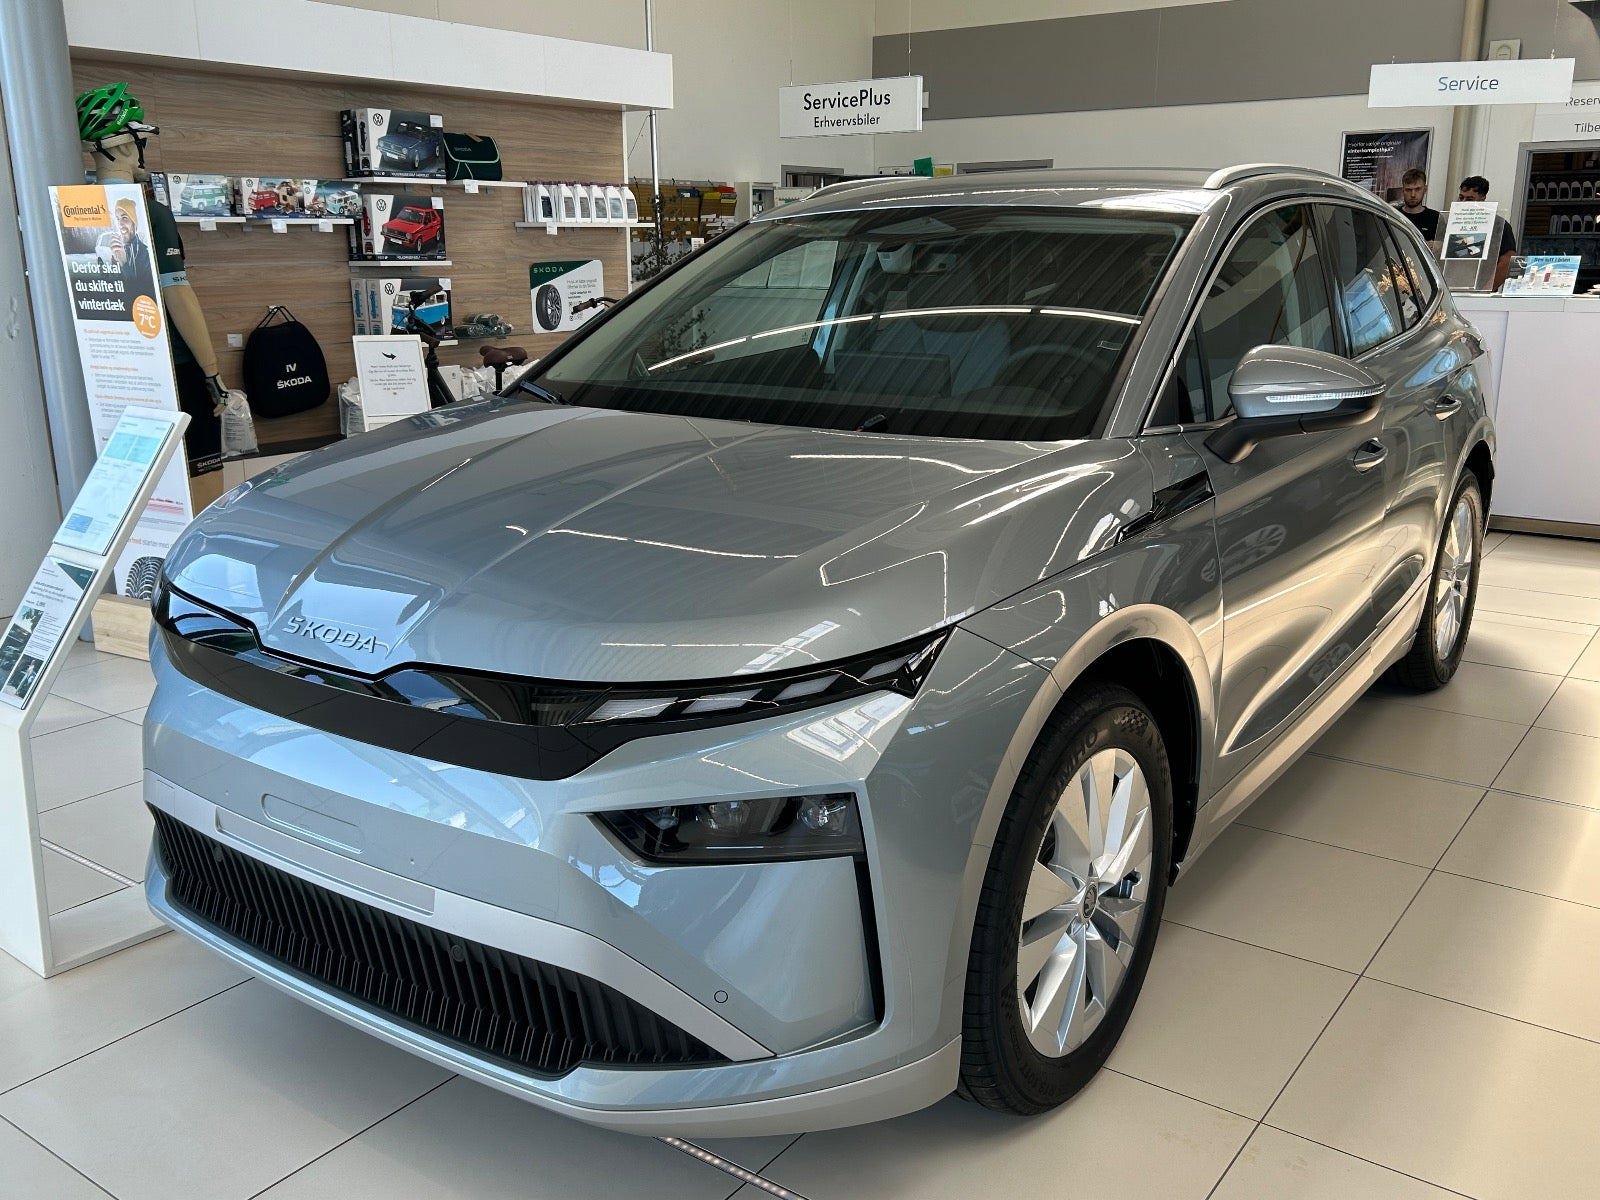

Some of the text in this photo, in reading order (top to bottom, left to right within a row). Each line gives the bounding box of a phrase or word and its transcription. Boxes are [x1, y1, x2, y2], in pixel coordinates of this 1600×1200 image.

[1438, 75, 1499, 91] Service
[803, 88, 891, 111] ServicePlus
[1565, 97, 1600, 106] Reser
[814, 113, 881, 128] Erhvervsbiler
[63, 204, 100, 218] Continental
[71, 261, 122, 274] Derfor skal
[75, 279, 125, 293] du skifte til
[78, 297, 126, 312] vinterdæk
